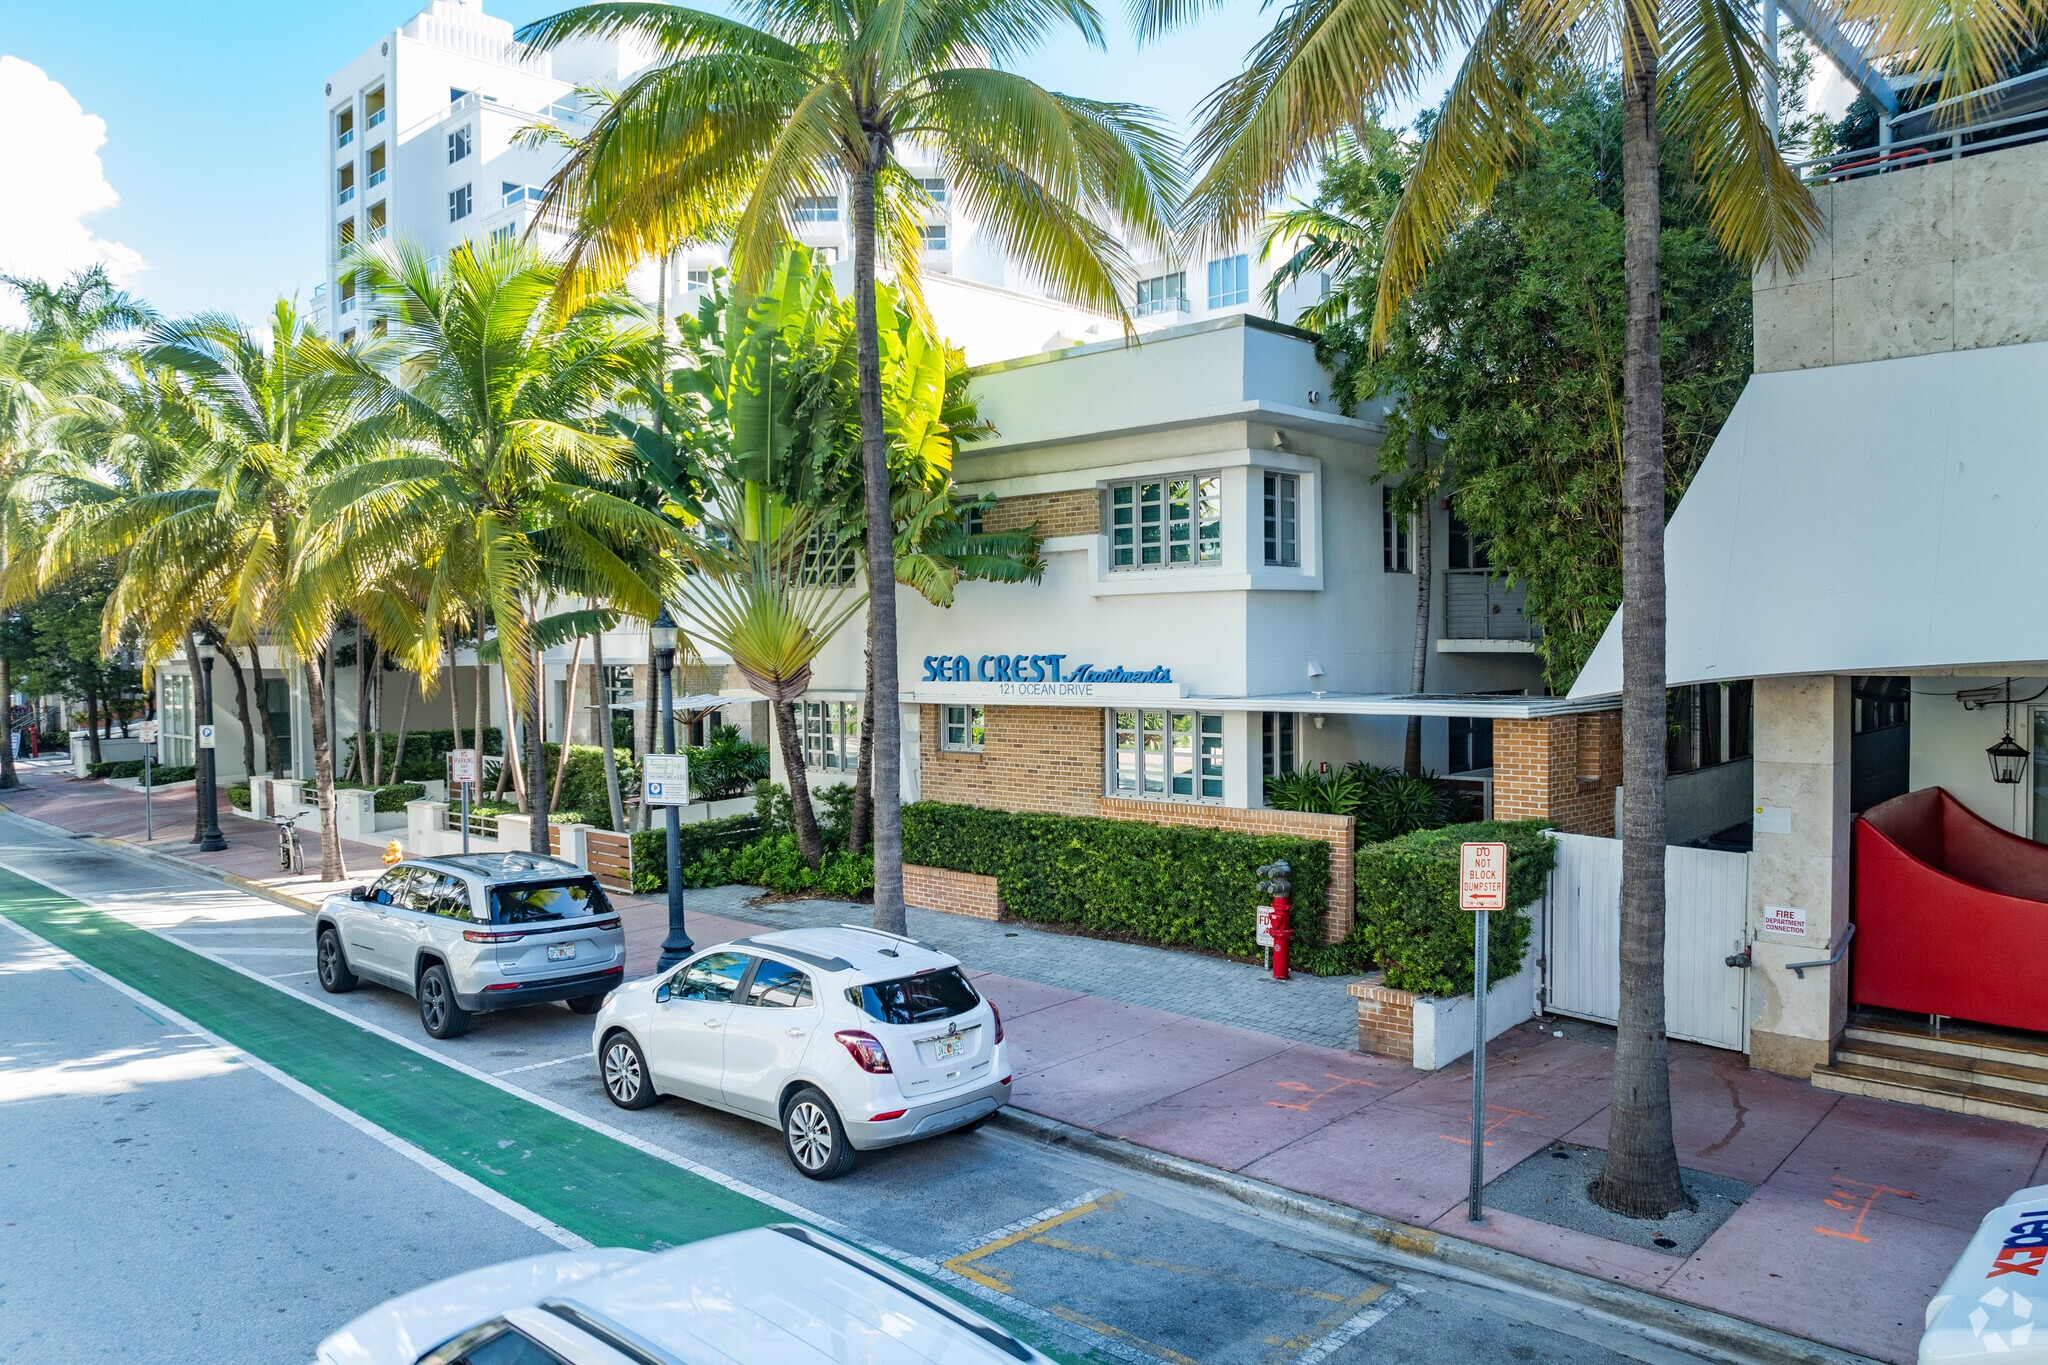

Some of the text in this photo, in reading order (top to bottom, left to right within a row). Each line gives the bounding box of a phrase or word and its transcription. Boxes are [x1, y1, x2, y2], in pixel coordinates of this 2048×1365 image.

[921, 654, 1173, 683] SEA CREST Apartments
[999, 683, 1093, 696] 121 OCEAN DRIVE
[1476, 847, 1491, 857] DO
[1475, 859, 1491, 868] NOT
[1469, 870, 1496, 880] BLOCK
[1464, 882, 1502, 891] DUMPSTER
[1775, 909, 1795, 919] FIRE
[1259, 915, 1270, 926] FD
[1765, 917, 1805, 927] DEPARTMENT
[1765, 924, 1805, 934] CONNECTION
